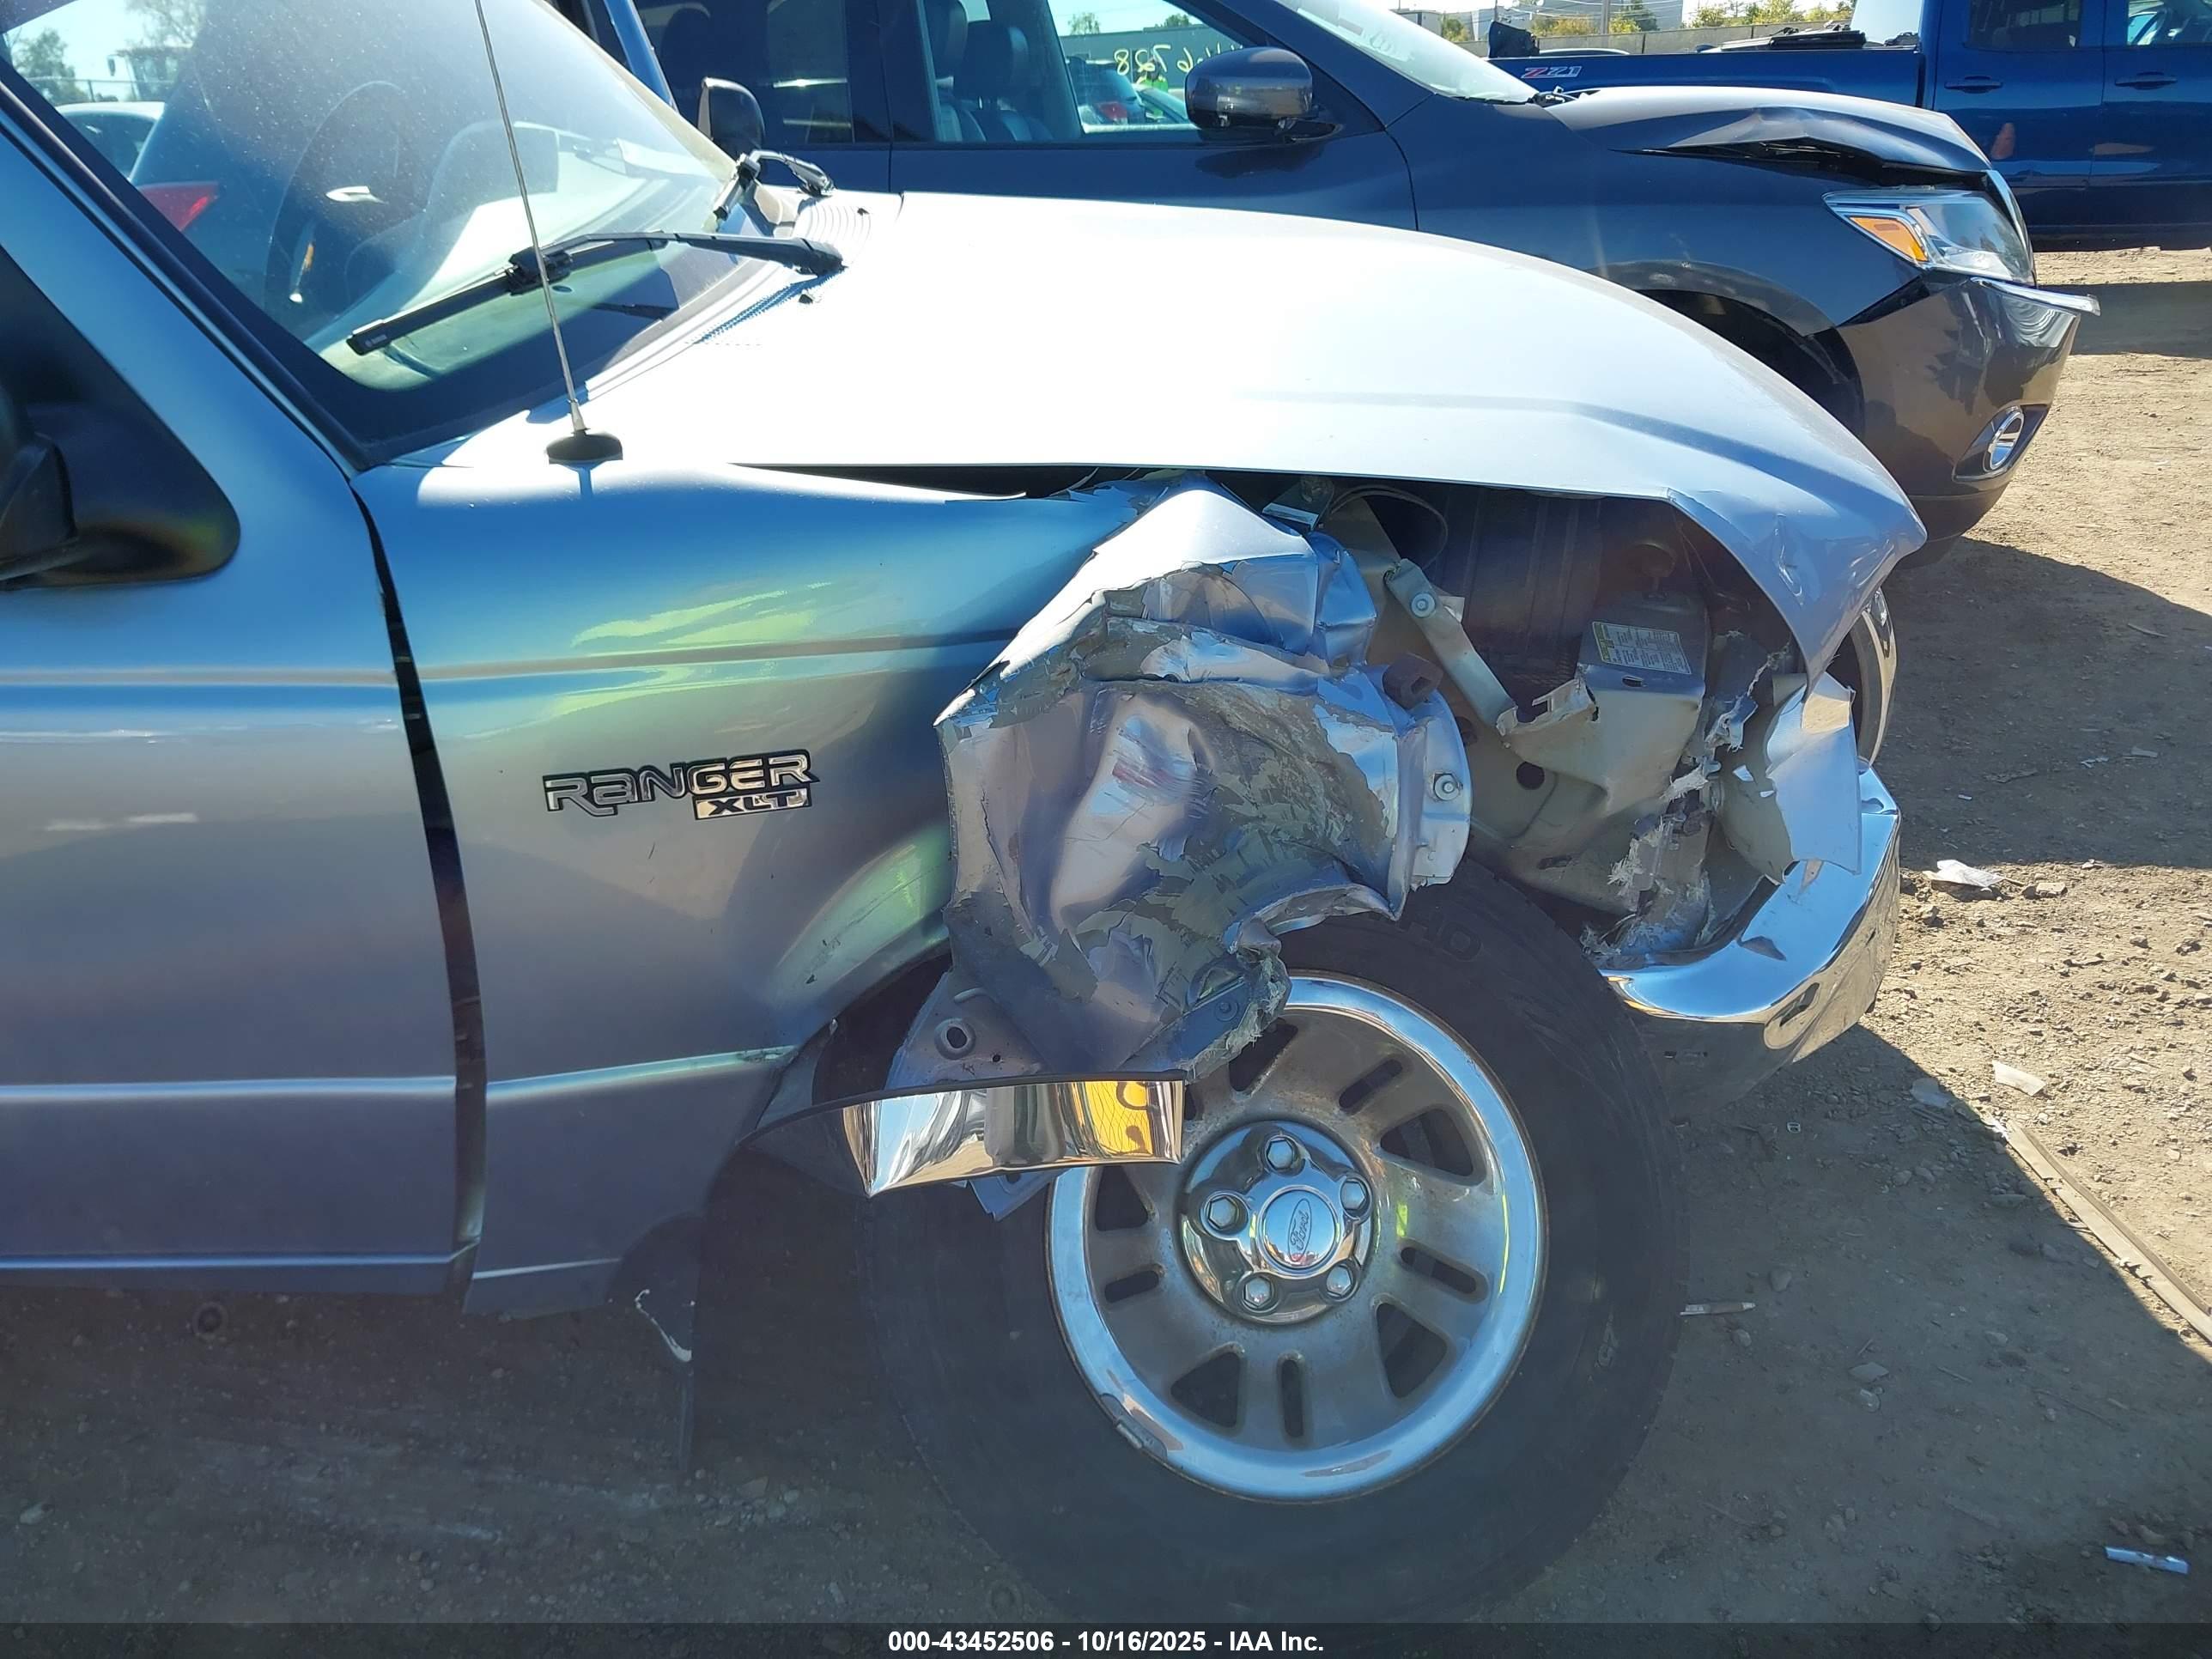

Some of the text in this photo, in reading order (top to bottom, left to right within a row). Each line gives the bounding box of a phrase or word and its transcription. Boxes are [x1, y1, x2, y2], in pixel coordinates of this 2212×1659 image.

[1521, 65, 1583, 79] Z71
[694, 787, 812, 819] XLT
[1290, 1210, 1310, 1251] Ford
